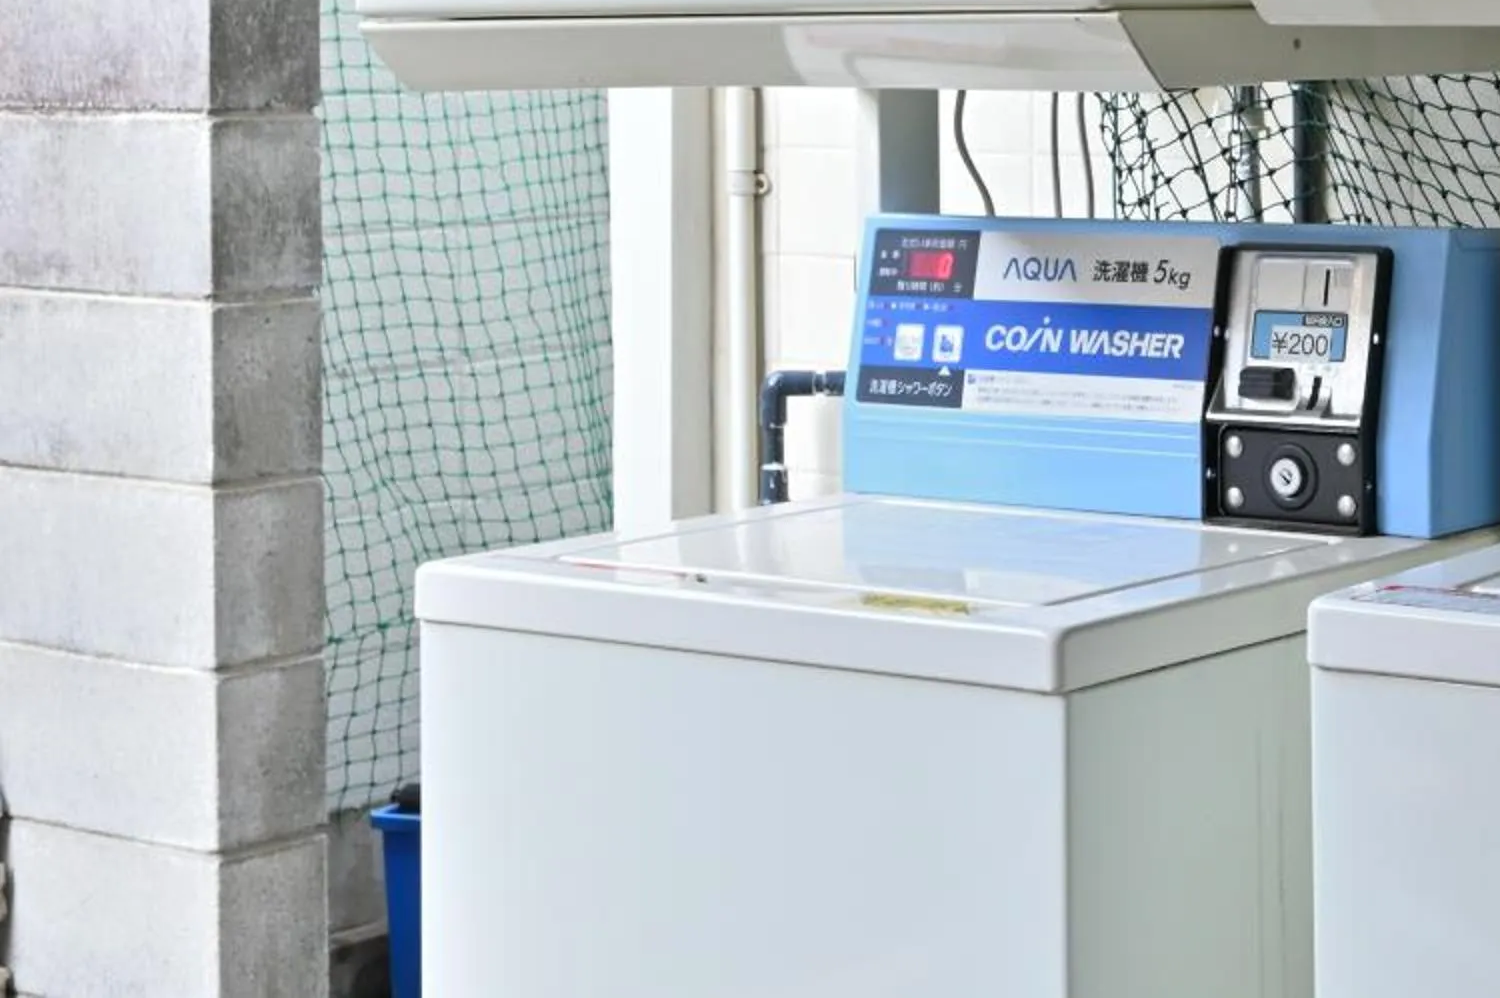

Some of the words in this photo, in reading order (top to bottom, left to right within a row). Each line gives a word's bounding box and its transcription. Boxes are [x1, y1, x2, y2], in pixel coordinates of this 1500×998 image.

[1003, 257, 1078, 283] AQUA
[1092, 258, 1149, 284] 洗濯機
[1153, 259, 1191, 291] 5kg
[1069, 328, 1186, 360] WASHER
[1271, 330, 1329, 358] ¥200
